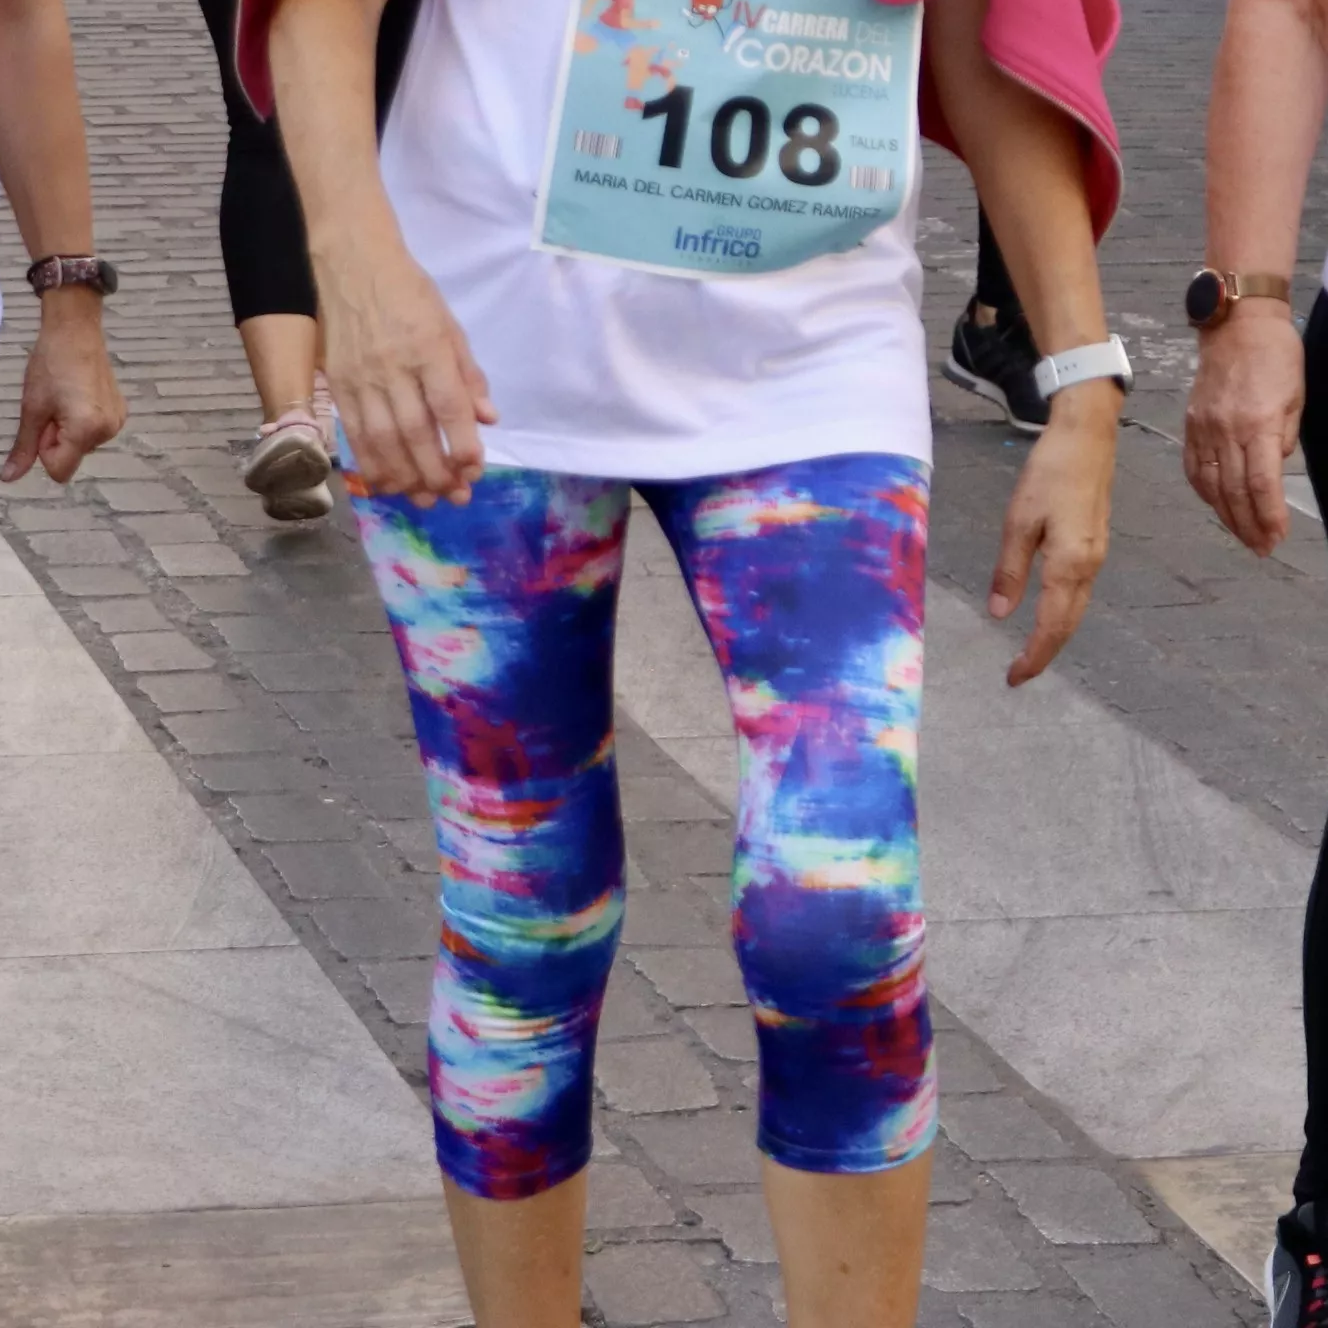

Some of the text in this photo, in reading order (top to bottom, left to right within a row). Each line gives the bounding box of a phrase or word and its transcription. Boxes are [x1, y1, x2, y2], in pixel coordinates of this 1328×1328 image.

[733, 0, 767, 29] IV
[760, 7, 849, 41] CARRERA
[736, 37, 892, 83] CORAZON
[642, 85, 842, 187] 108
[849, 135, 886, 150] TALLA
[575, 169, 628, 191] MARIA
[634, 179, 665, 197] DEL
[671, 185, 742, 208] CARMEN
[747, 195, 808, 215] GOMEZ
[675, 226, 760, 259] Infrico
